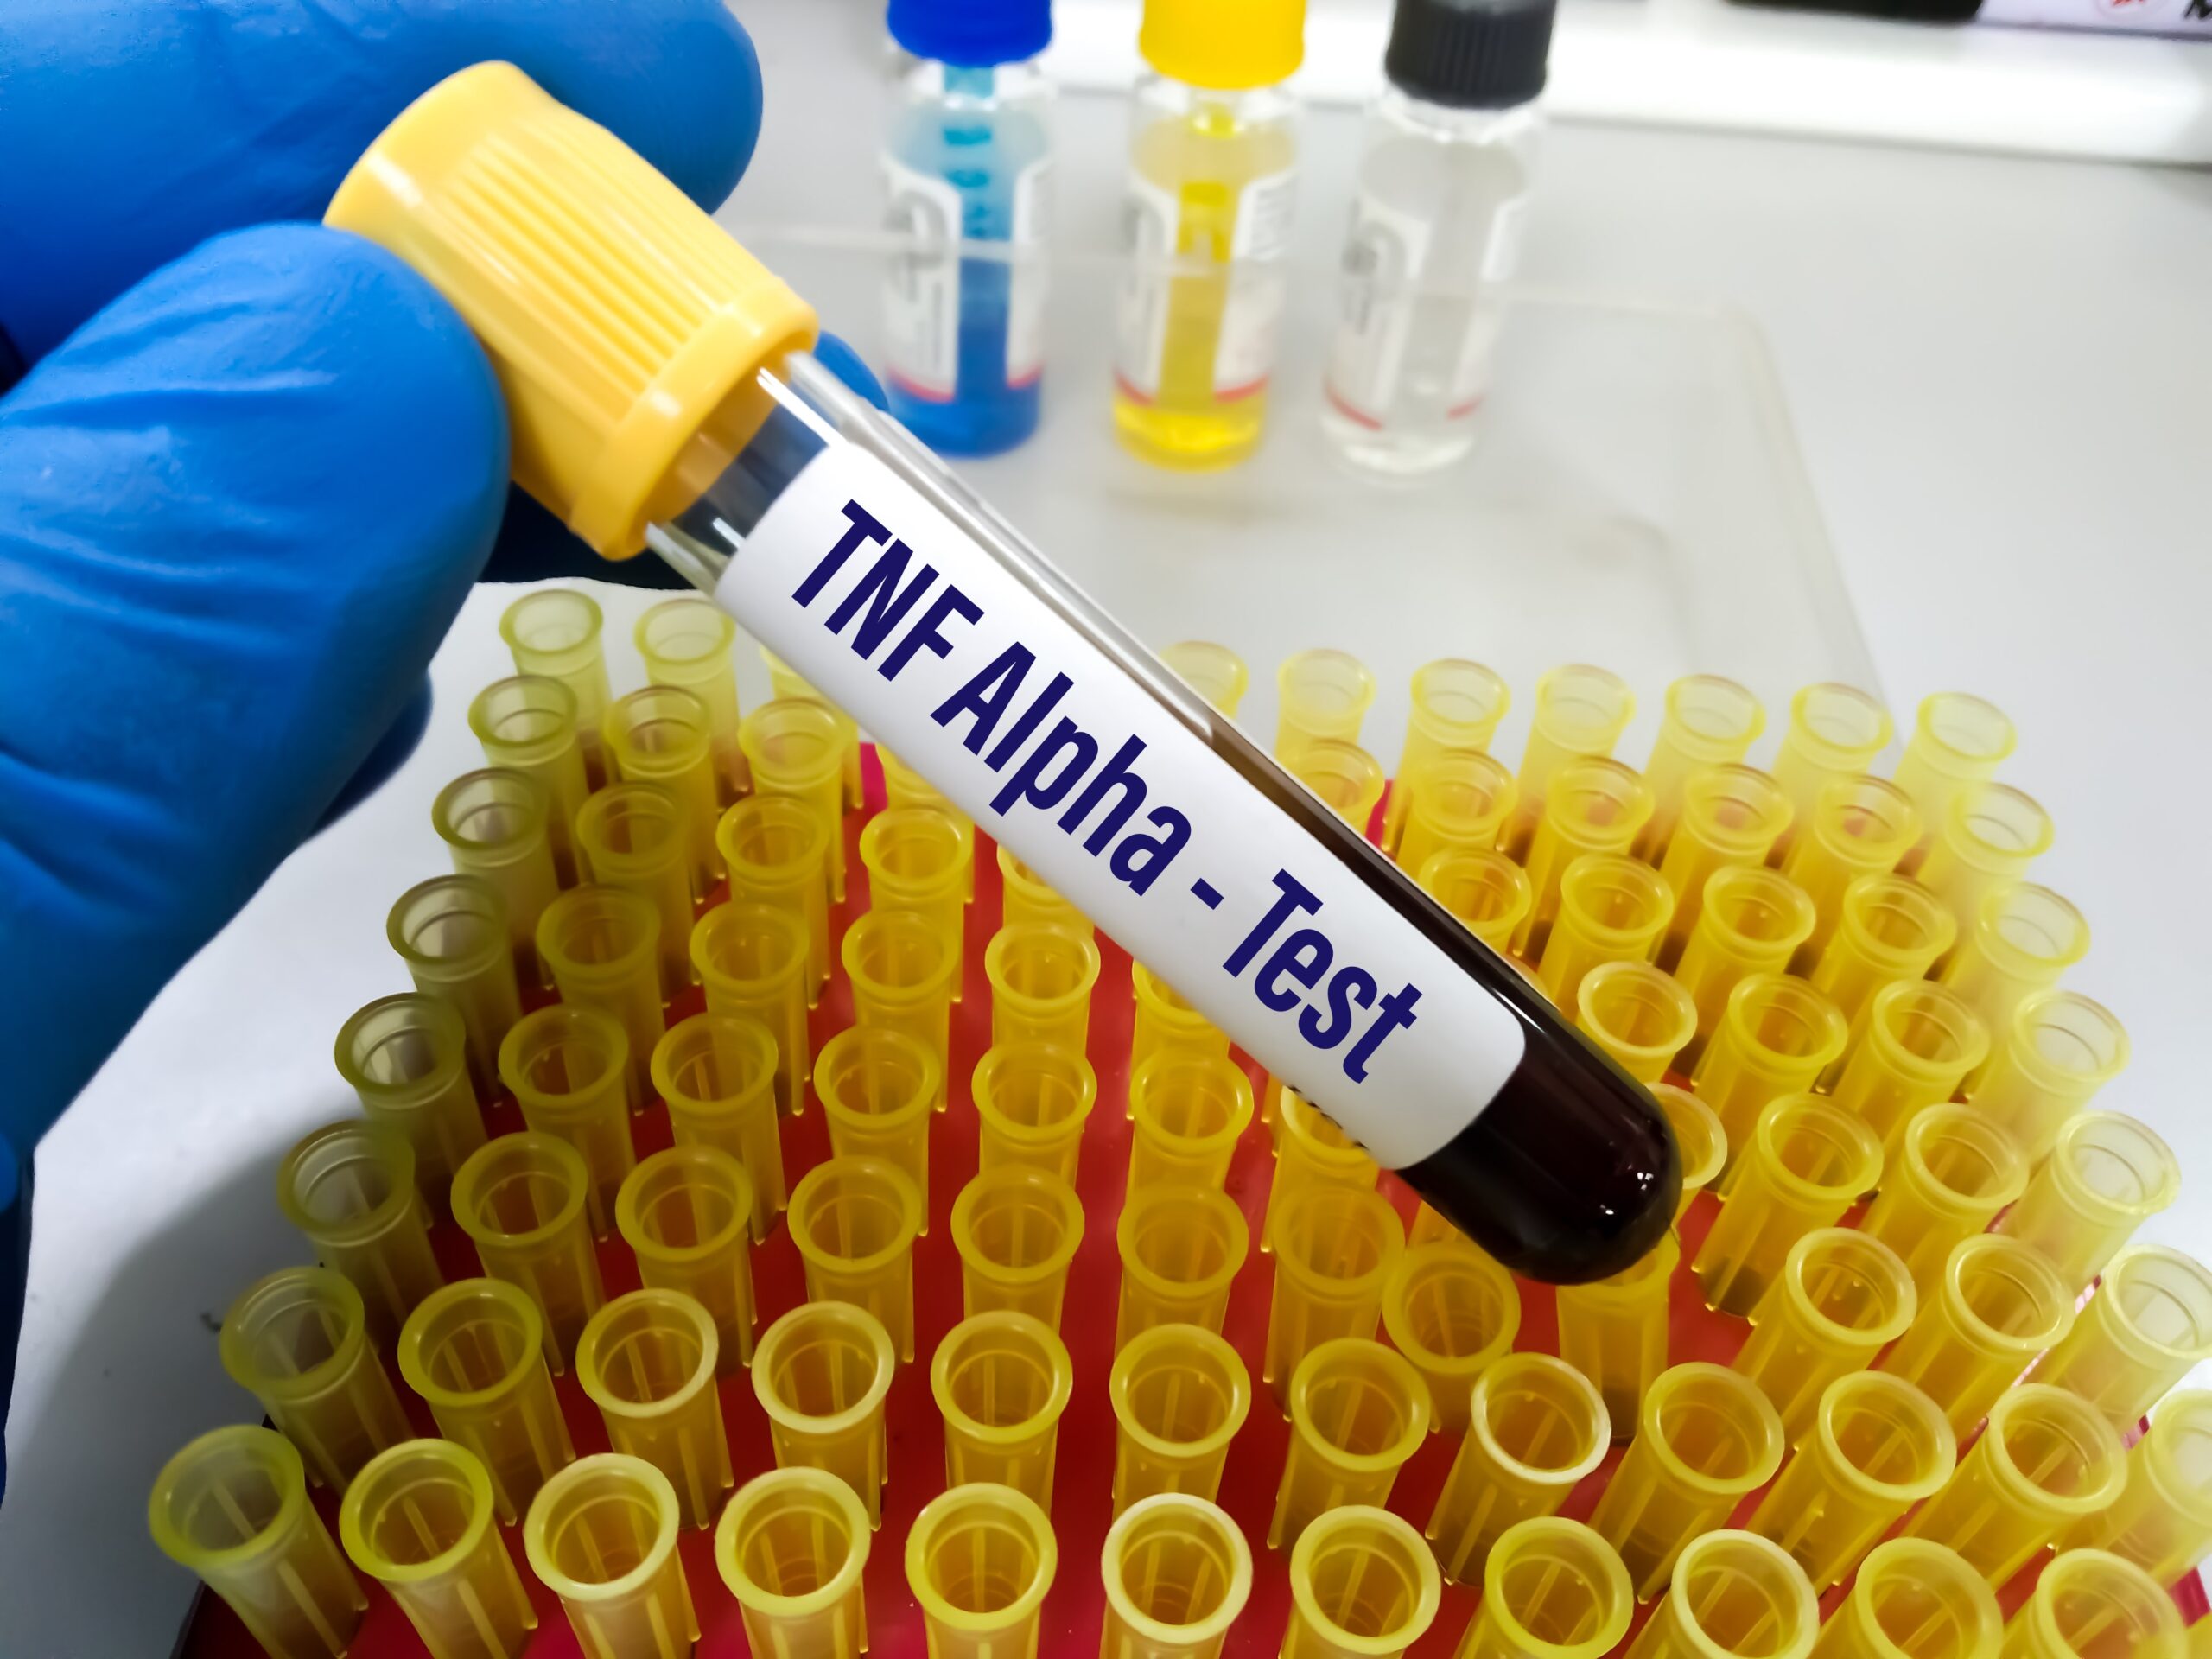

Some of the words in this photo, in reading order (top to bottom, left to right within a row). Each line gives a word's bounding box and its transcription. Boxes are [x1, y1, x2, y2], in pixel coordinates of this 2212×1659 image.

[791, 499, 985, 682] TNF
[930, 641, 1192, 897] Alpha
[1190, 877, 1224, 911] -
[1222, 868, 1423, 1084] Test
